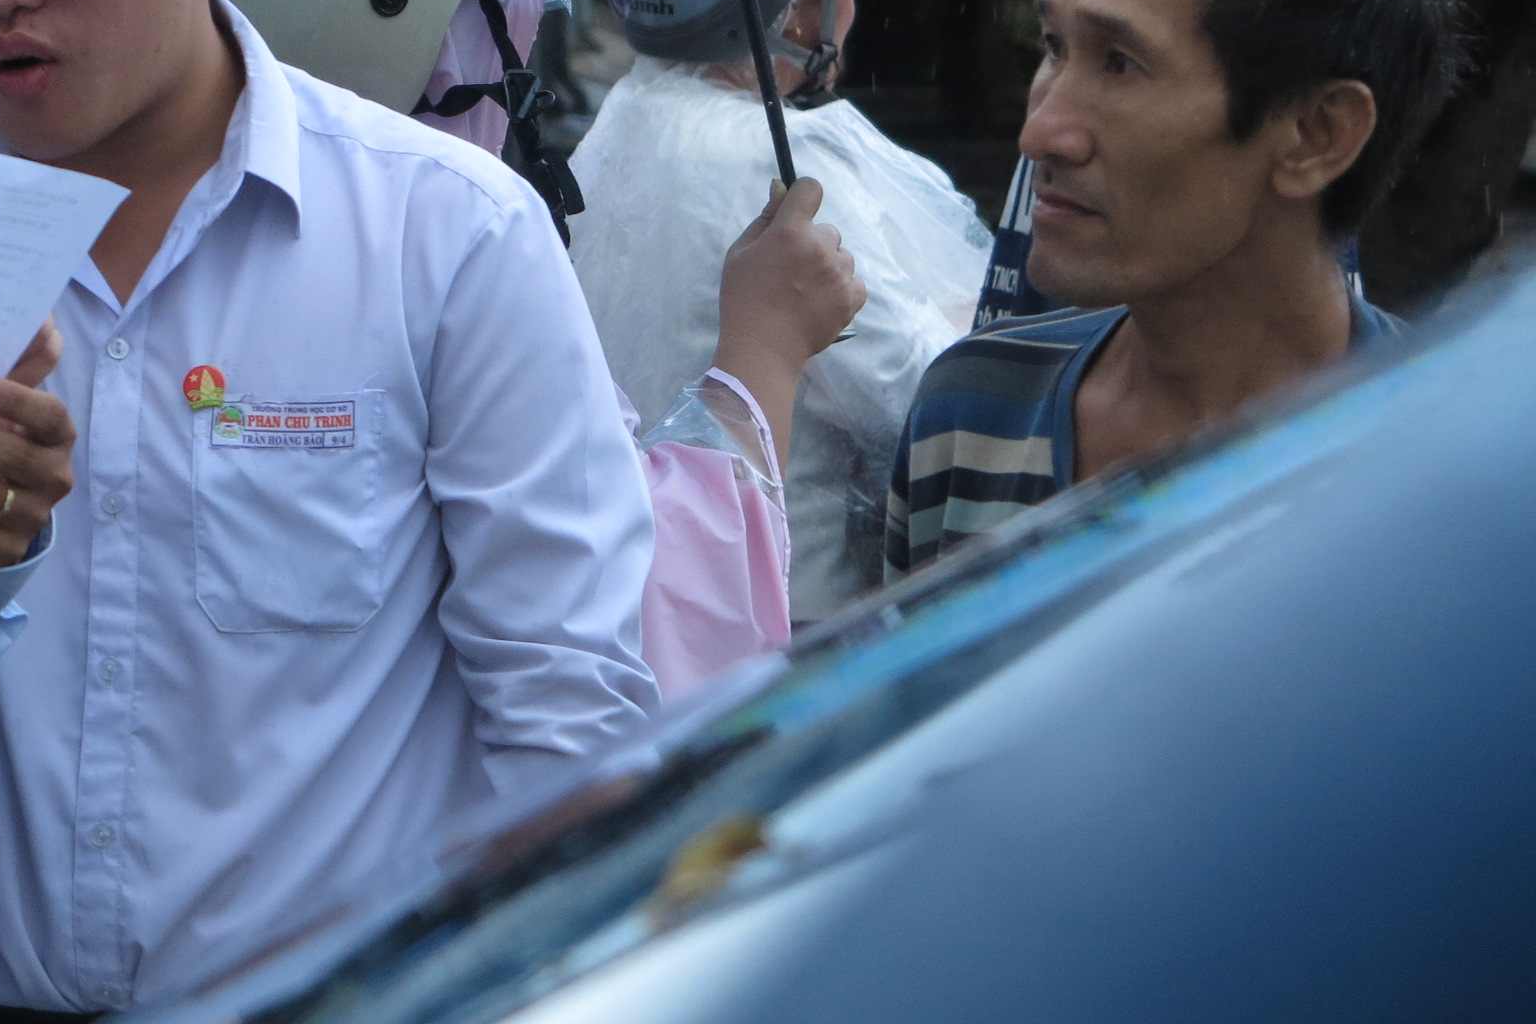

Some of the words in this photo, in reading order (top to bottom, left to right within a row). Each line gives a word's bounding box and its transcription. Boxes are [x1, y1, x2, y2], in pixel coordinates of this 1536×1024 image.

[247, 414, 281, 428] PHAN
[285, 416, 310, 429] CHU
[314, 414, 352, 428] TRINH
